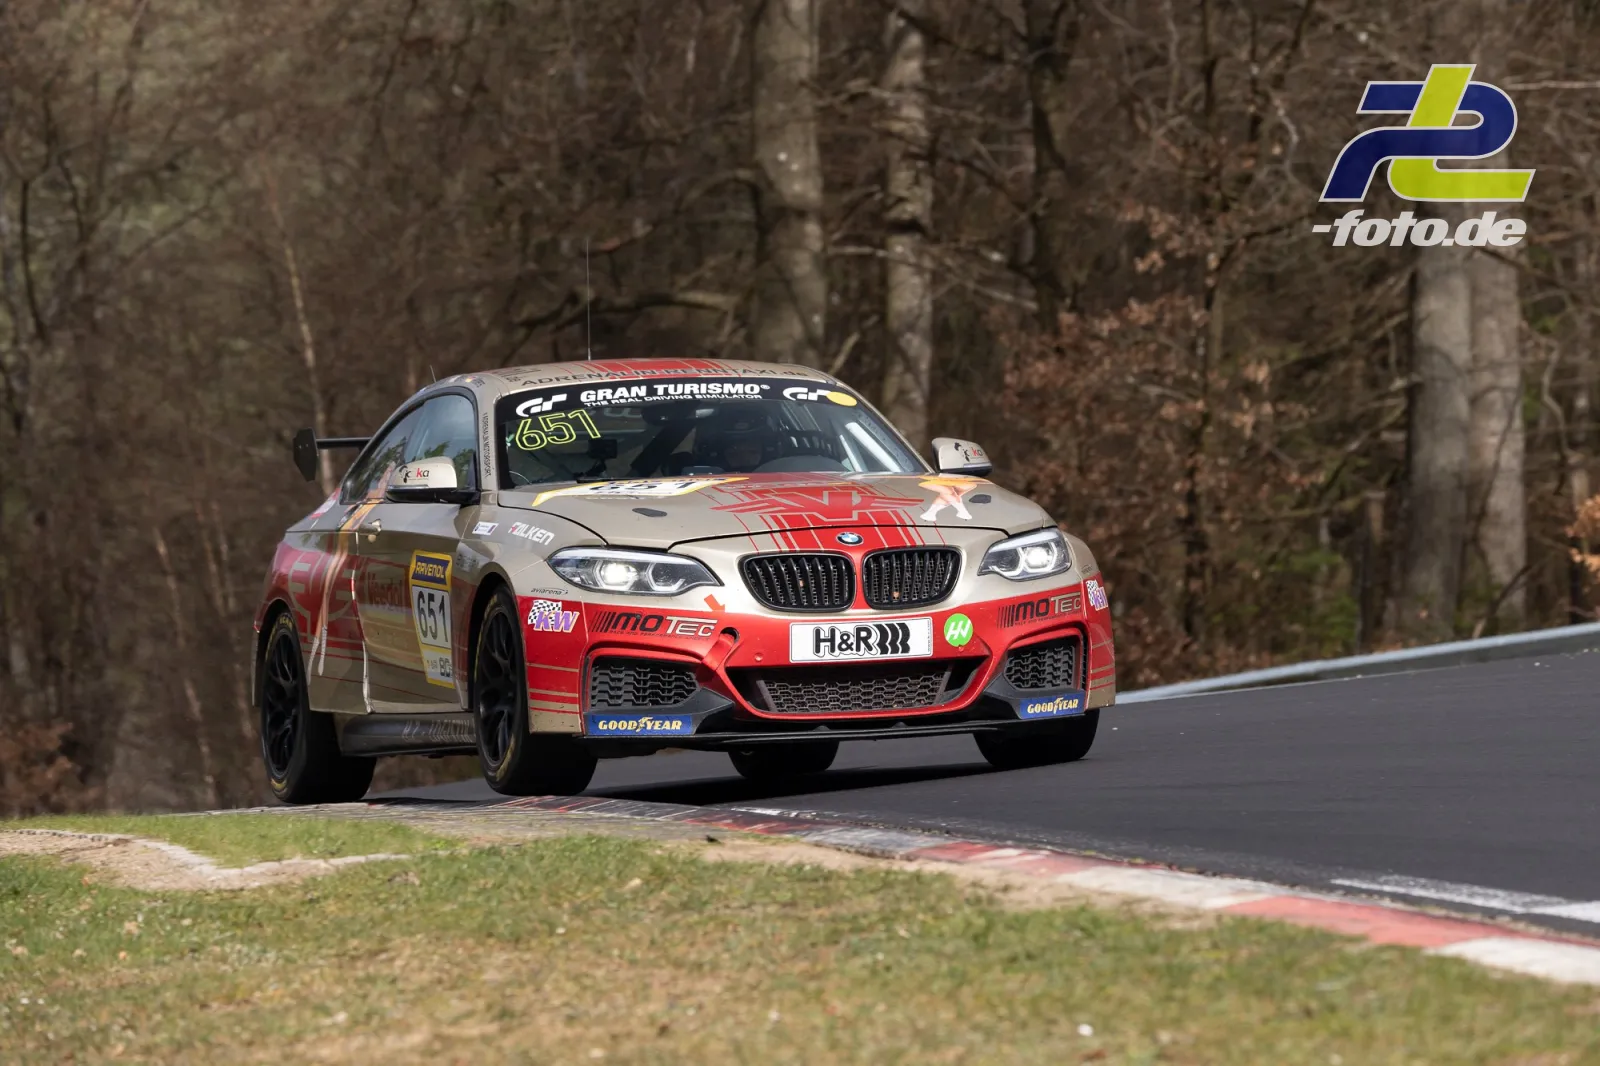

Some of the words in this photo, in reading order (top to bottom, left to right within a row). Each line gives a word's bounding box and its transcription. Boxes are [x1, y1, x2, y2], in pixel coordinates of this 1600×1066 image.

[580, 385, 647, 403] GRAN
[613, 398, 642, 406] REAL
[643, 394, 692, 402] DRIVING
[515, 409, 602, 451] 651
[508, 521, 555, 546] FALKEN
[414, 561, 446, 579] RAVENOL
[417, 590, 449, 643] 651
[534, 610, 580, 634] KW
[813, 625, 877, 656] H&R
